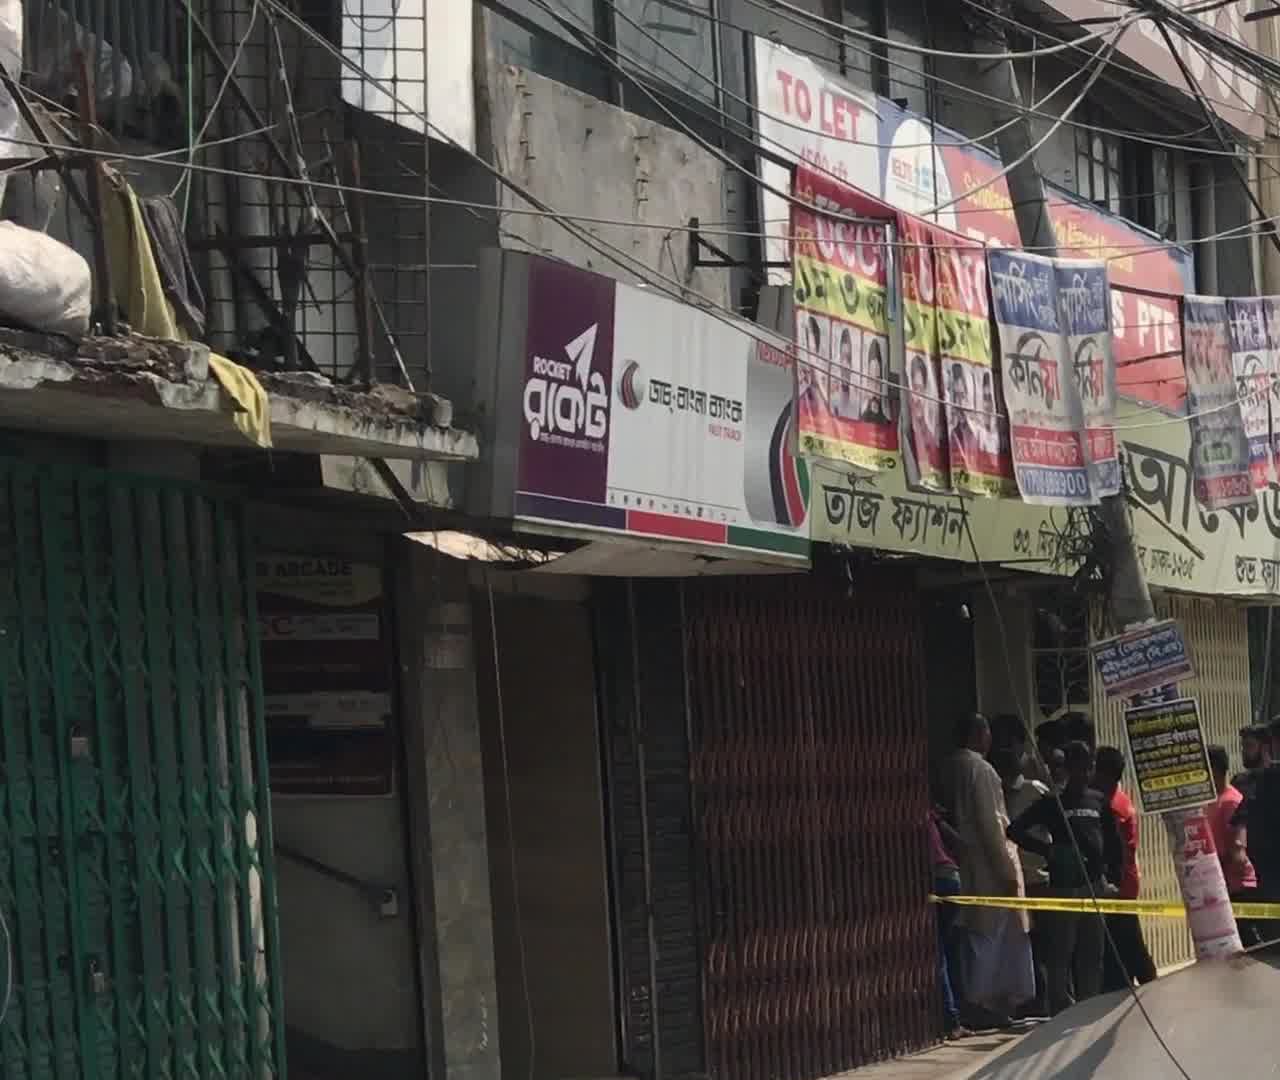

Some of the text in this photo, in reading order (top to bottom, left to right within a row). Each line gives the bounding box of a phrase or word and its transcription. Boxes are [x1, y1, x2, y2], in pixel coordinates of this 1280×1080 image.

[777, 70, 861, 145] TO LET
[1136, 298, 1176, 352] PTE
[532, 355, 573, 381] ROCKET
[890, 495, 968, 546] ফ্যাশন
